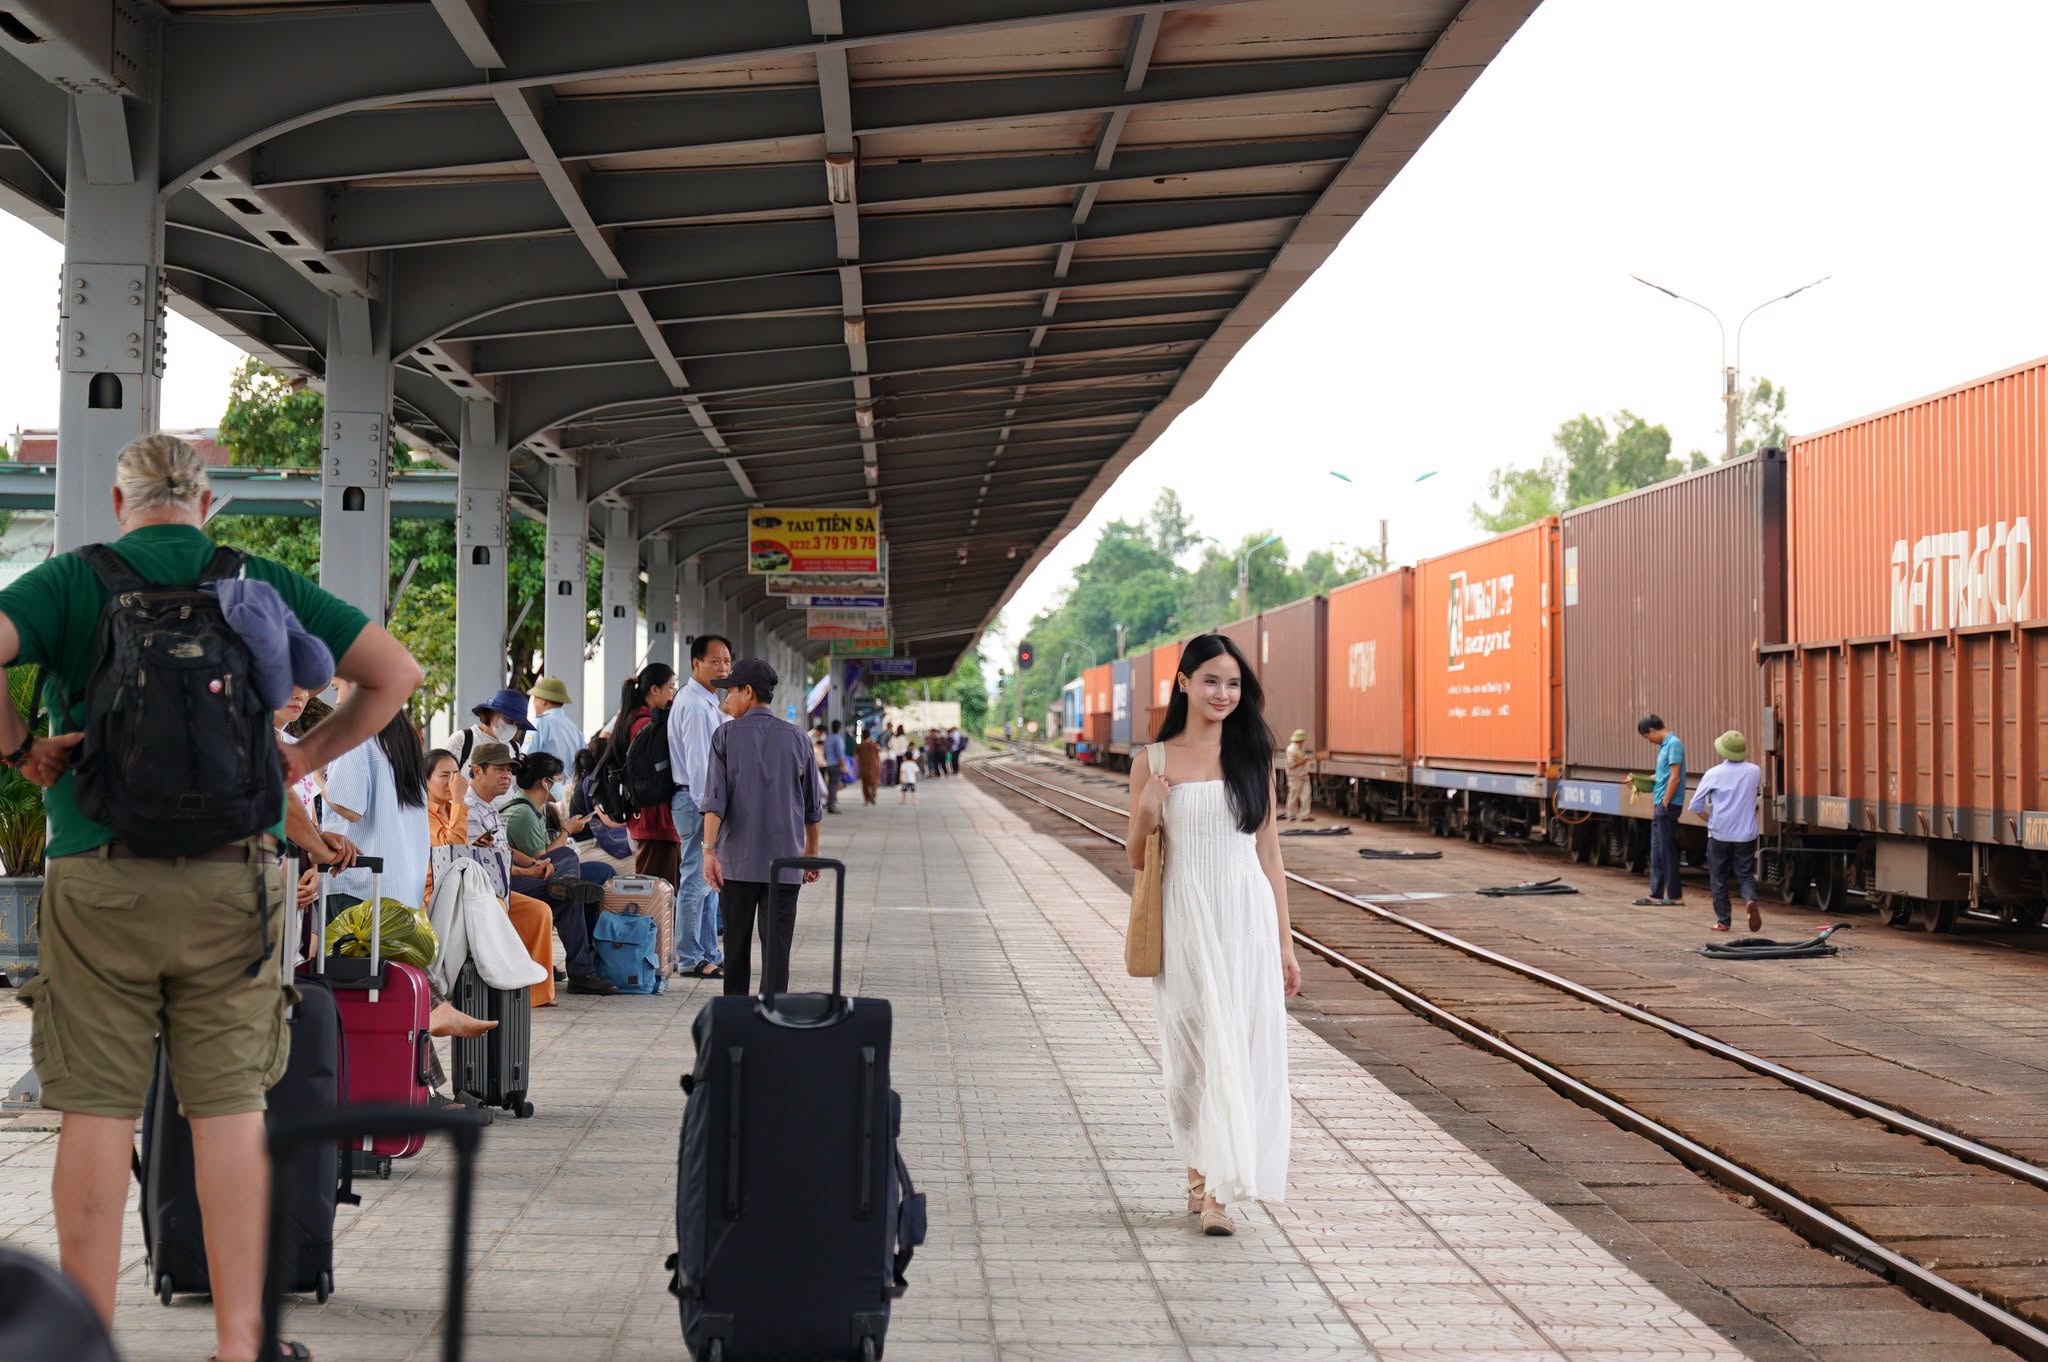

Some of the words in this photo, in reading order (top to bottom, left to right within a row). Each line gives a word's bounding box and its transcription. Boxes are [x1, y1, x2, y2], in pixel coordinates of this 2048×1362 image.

[787, 520, 814, 532] TAXI
[816, 512, 852, 532] TIÊN
[855, 517, 875, 532] SA
[824, 535, 839, 550] 79
[842, 535, 857, 550] 79
[860, 535, 876, 550] 79
